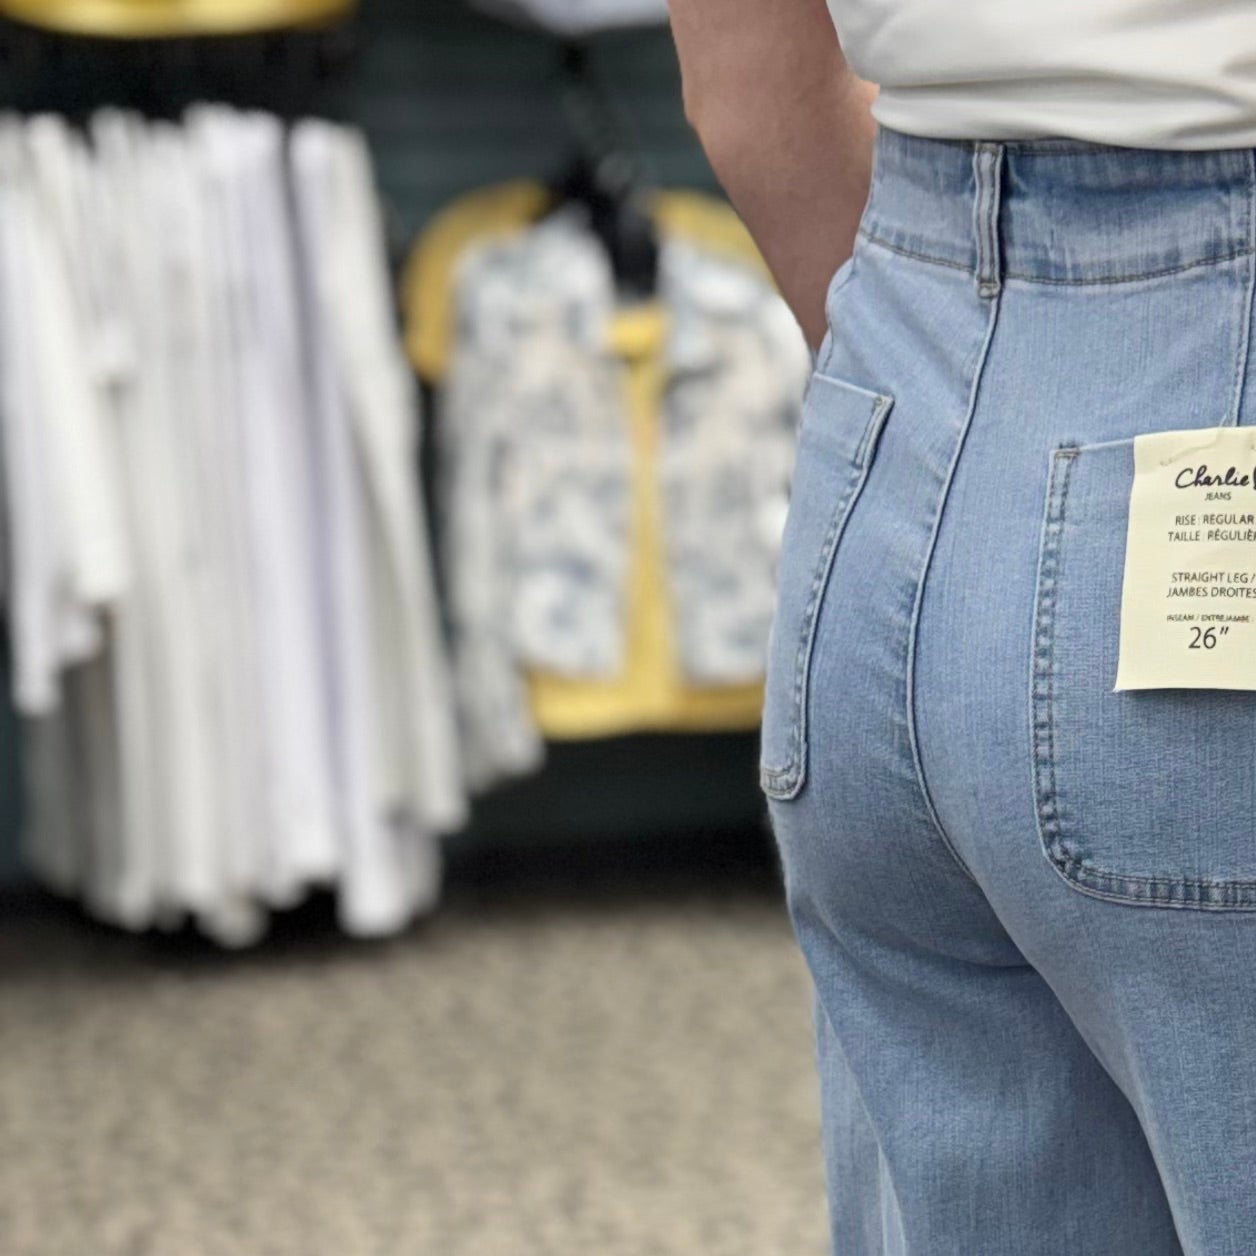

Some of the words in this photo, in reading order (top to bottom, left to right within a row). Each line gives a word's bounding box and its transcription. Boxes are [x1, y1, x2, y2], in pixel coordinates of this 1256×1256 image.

[1204, 491, 1232, 501] JEANS
[1172, 572, 1225, 583] STRAIGHT
[1227, 572, 1248, 584] LEG
[1166, 586, 1208, 598] JAMBES
